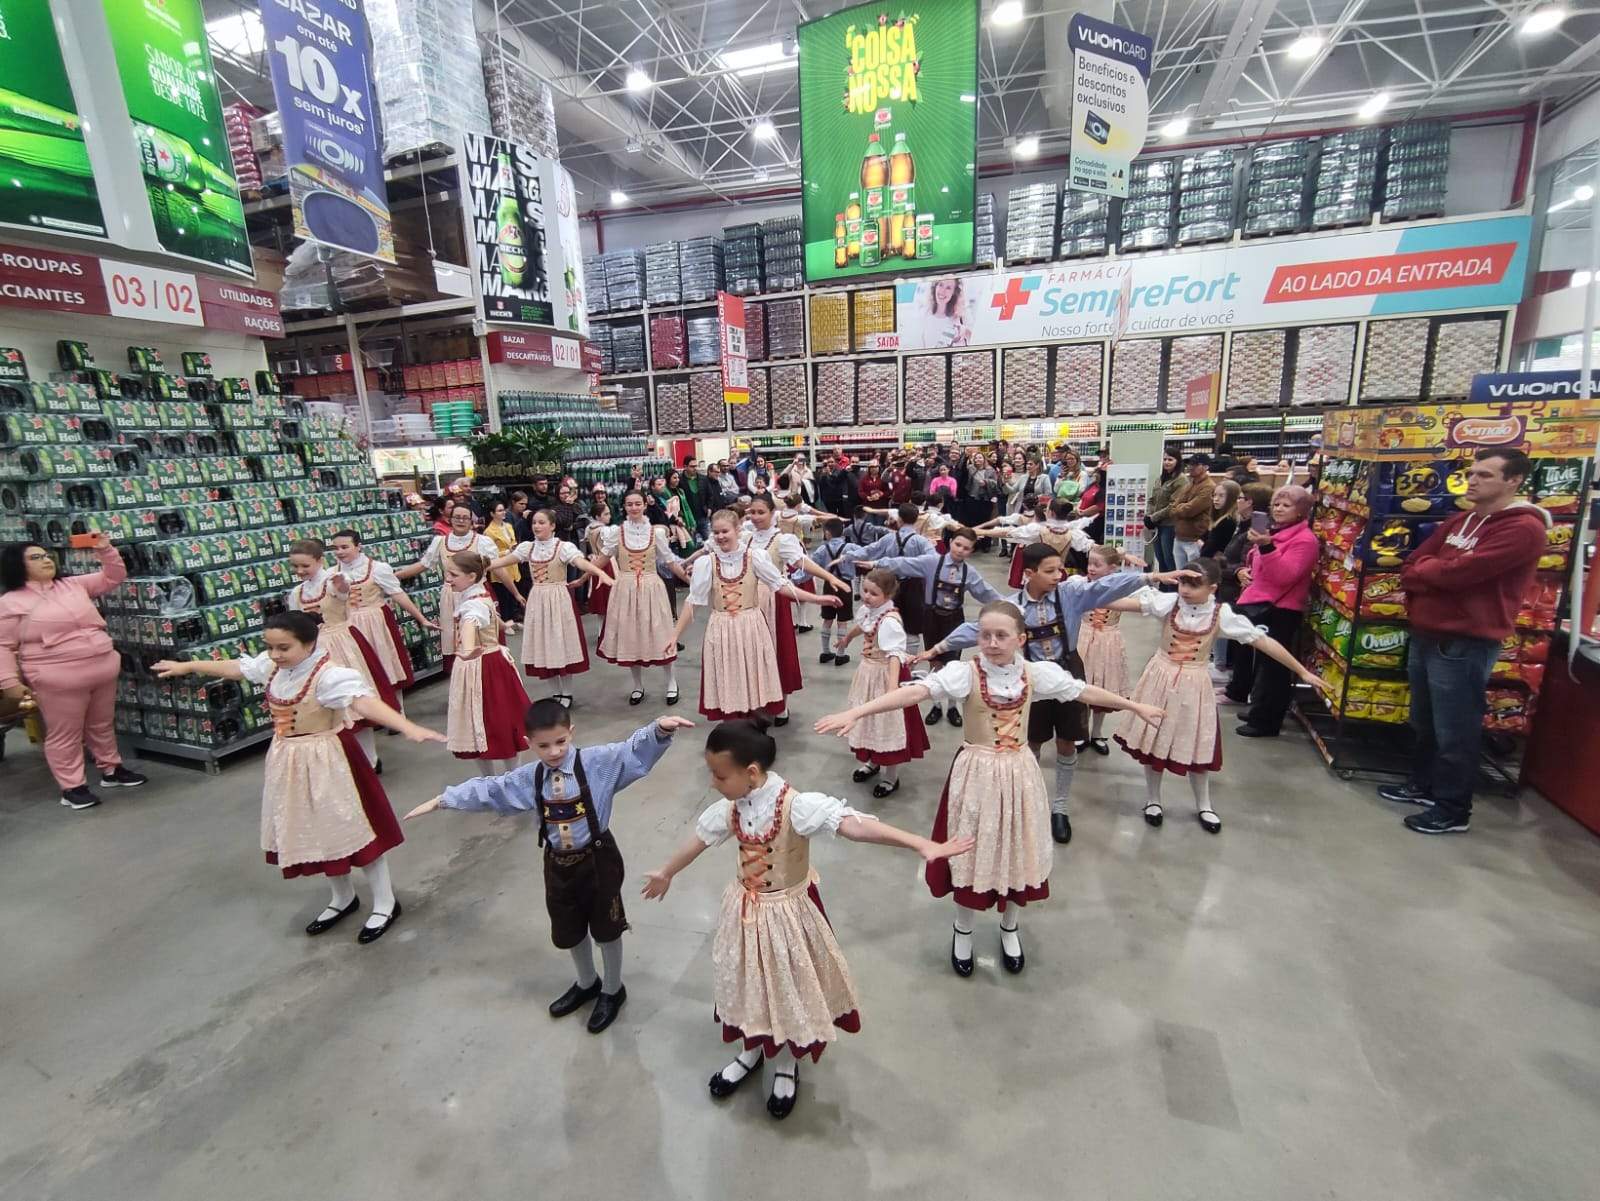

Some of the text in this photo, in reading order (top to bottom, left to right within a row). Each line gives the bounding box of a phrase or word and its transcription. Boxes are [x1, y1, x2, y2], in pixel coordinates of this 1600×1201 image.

[852, 22, 916, 74] COISA
[849, 63, 917, 113] NOSSA
[1078, 75, 1127, 98] descontos
[294, 96, 325, 119] sem
[1077, 92, 1126, 114] exclusivos
[1279, 256, 1493, 294] AO LADO DA ENTRADA
[220, 287, 274, 308] UTILIDADES
[244, 316, 281, 332] RAÇÕES
[1042, 324, 1081, 337] Nosso
[1131, 315, 1176, 332] cuidar
[1177, 311, 1197, 327] de
[1200, 309, 1235, 325] você
